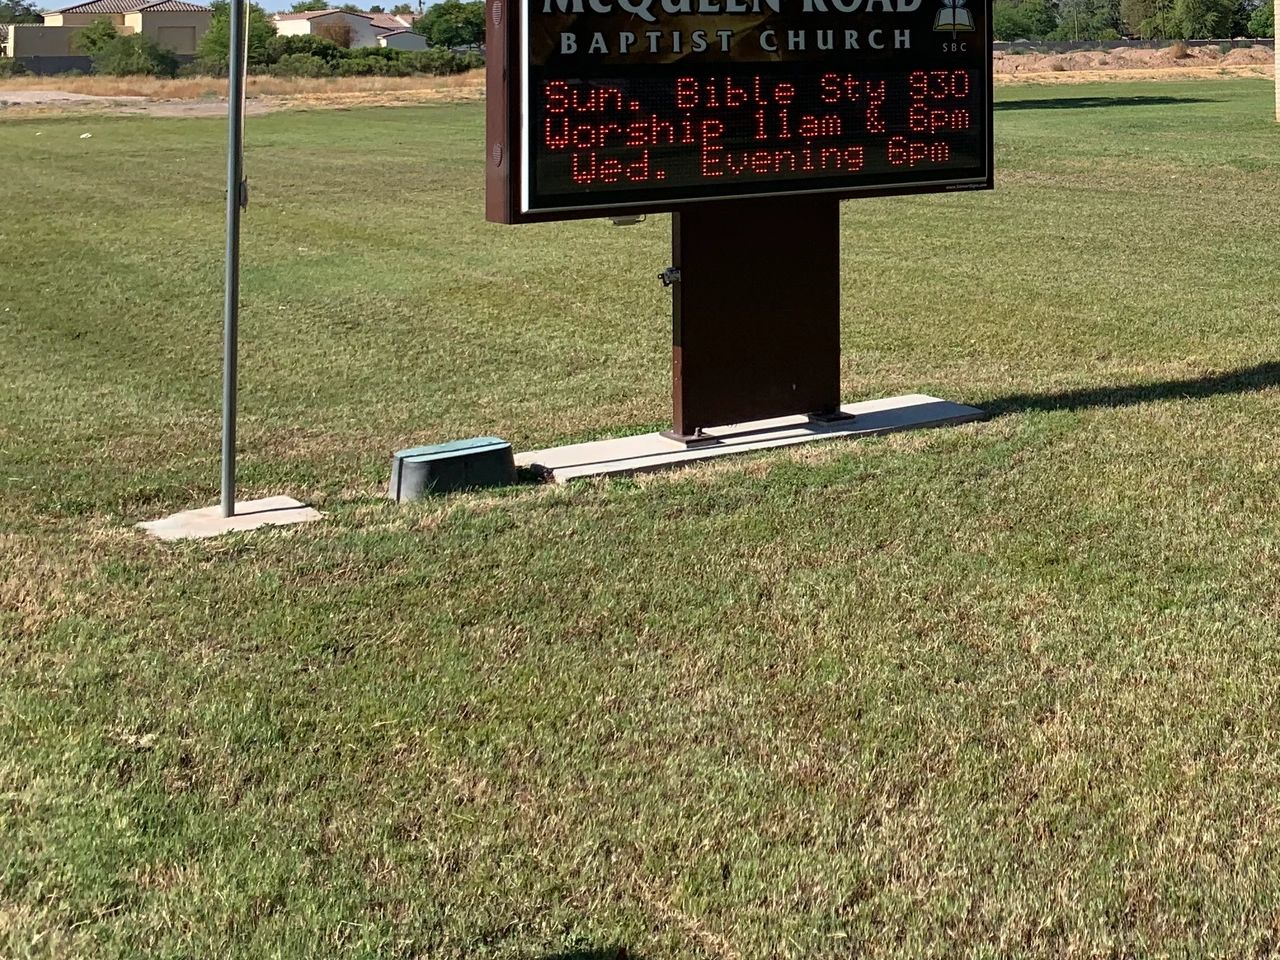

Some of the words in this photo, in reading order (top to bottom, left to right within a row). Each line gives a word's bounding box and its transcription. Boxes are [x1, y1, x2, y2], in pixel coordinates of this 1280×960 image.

[559, 31, 733, 55] BAPTIST
[759, 29, 911, 51] CHURCH
[942, 42, 968, 53] SBC
[544, 80, 640, 113] Sun.
[676, 75, 795, 108] Bible
[820, 72, 886, 105] Sty
[909, 70, 969, 99] 930
[545, 112, 724, 149] Worship
[754, 109, 841, 138] 11am
[866, 106, 886, 133] &
[909, 102, 970, 135] 6pm
[573, 149, 666, 184] Wed.
[703, 140, 864, 177] Evening
[887, 135, 950, 168] 6pm
